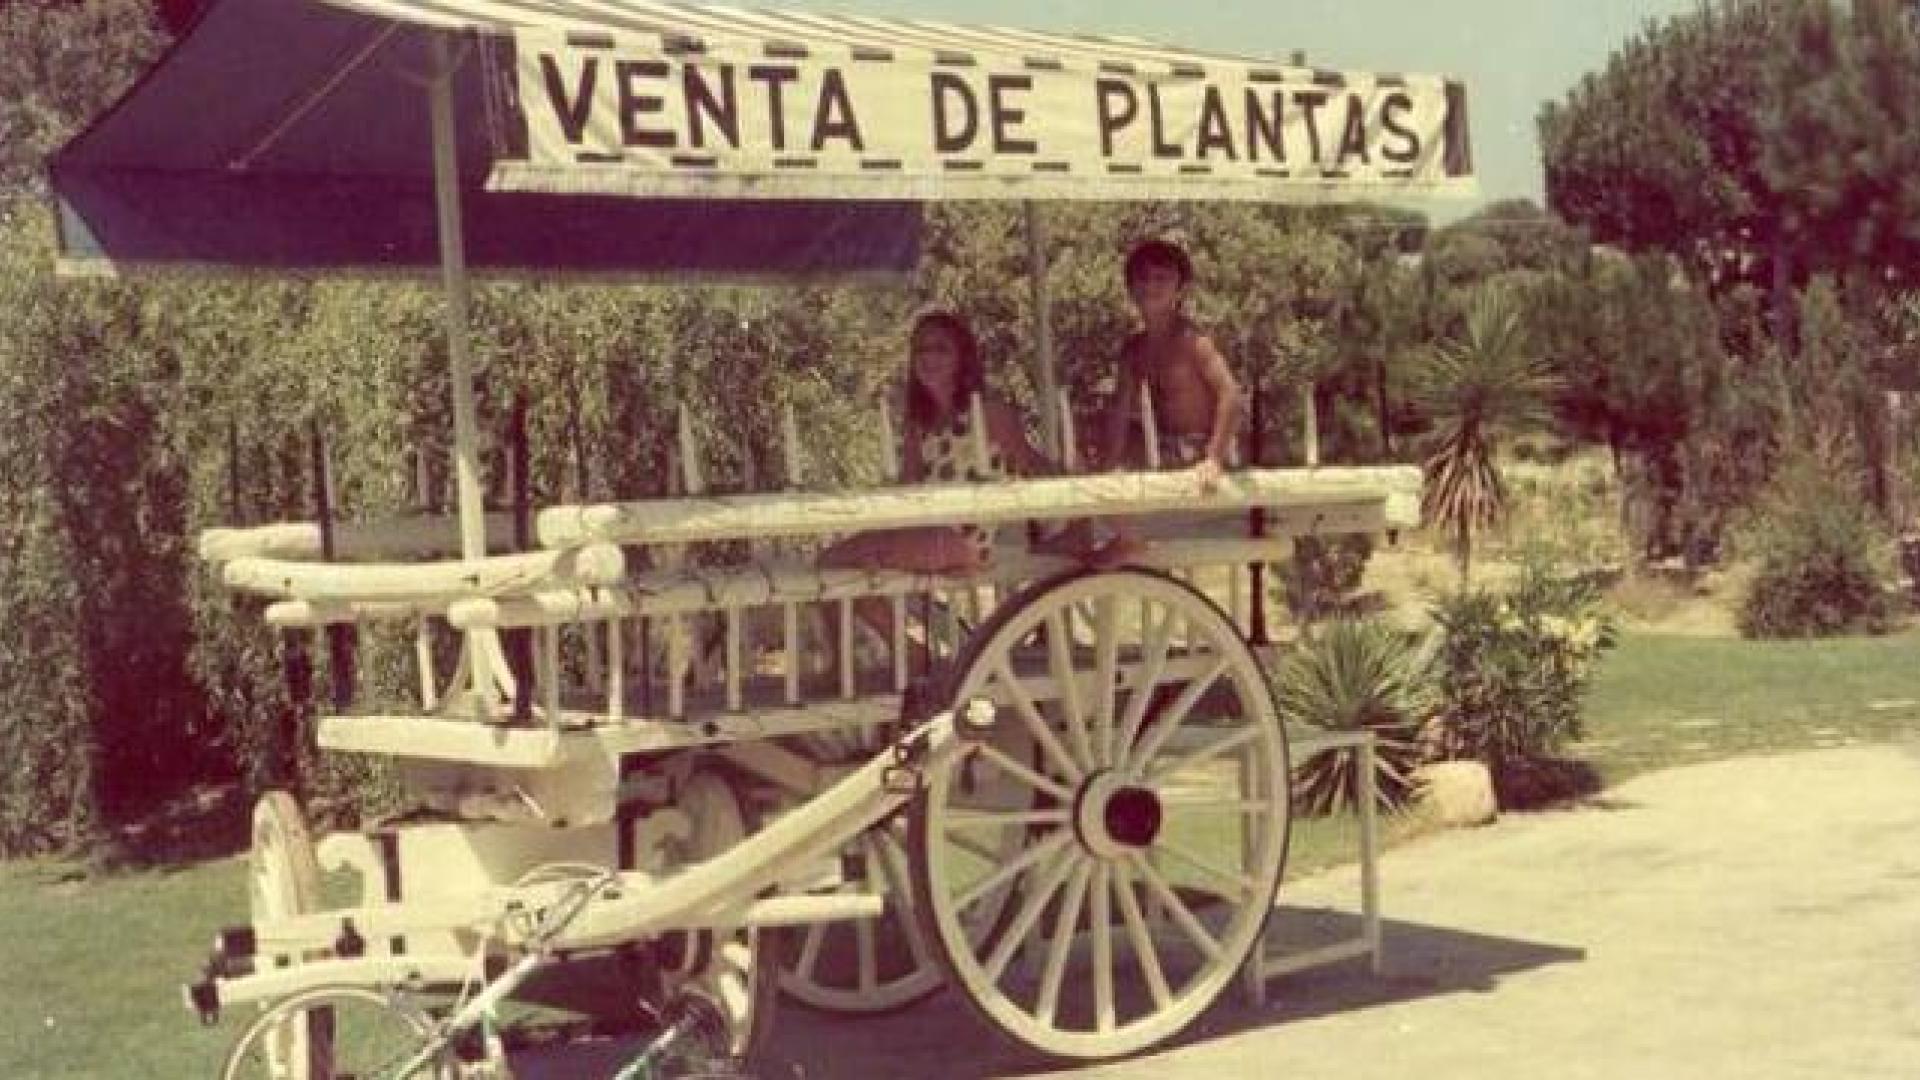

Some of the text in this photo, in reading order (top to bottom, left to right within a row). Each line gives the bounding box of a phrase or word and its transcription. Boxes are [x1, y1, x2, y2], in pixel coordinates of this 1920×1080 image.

[539, 53, 1421, 164] VENTA DE PLANTAS
